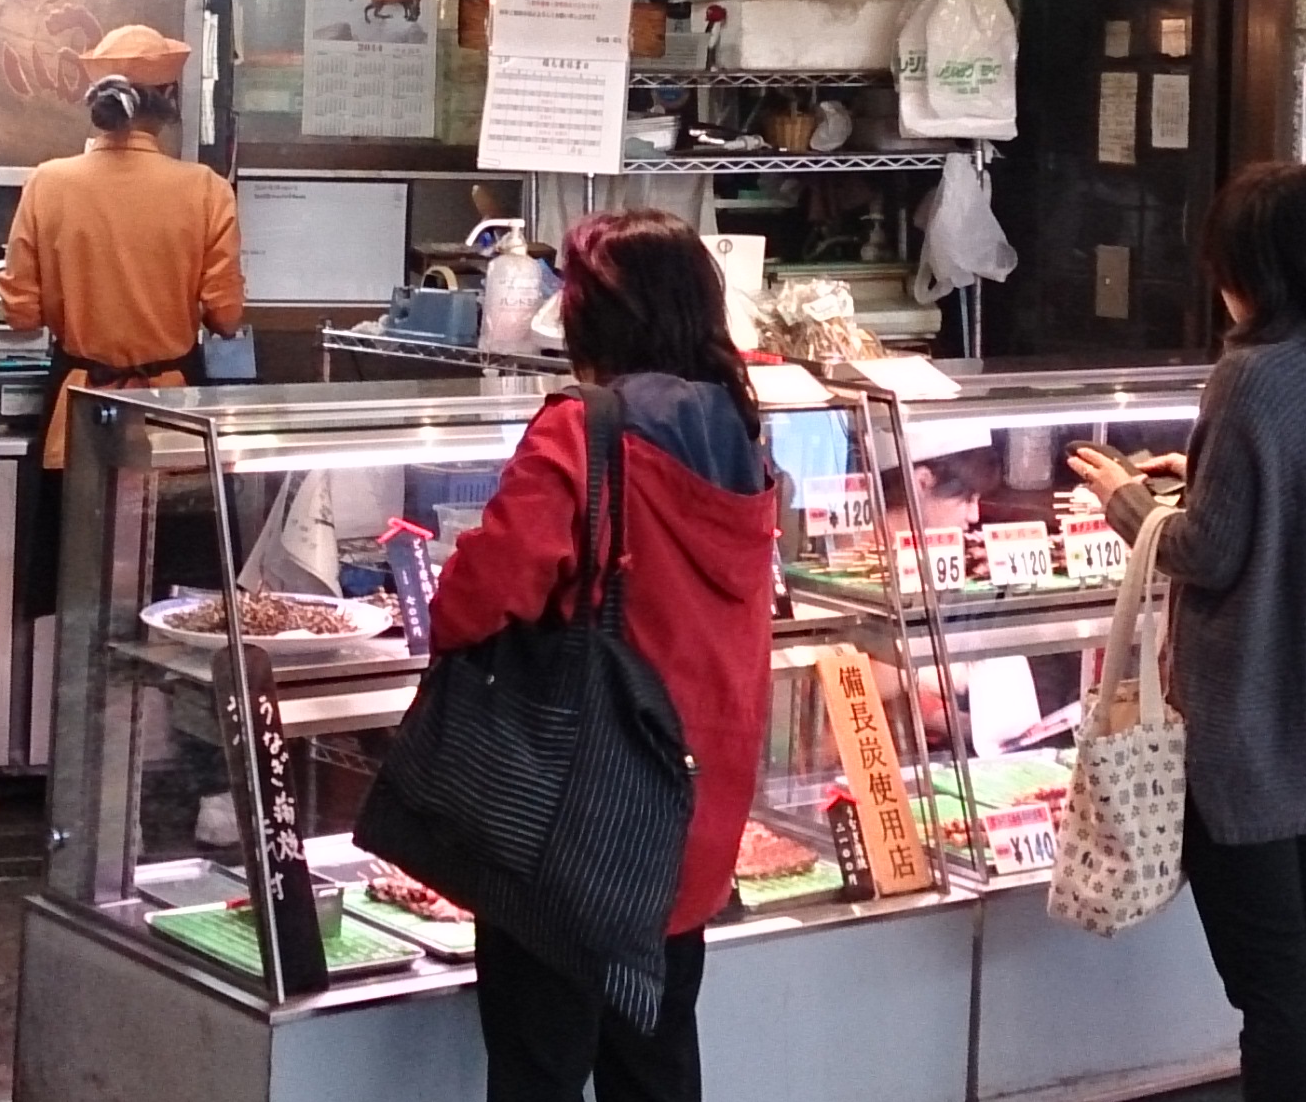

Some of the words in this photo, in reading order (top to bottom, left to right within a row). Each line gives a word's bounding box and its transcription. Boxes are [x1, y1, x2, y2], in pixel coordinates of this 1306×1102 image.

[1009, 550, 1047, 578] ¥120
[1084, 540, 1121, 569] ¥120
[839, 665, 916, 880] 備長炭使用店
[1010, 832, 1054, 866] ¥140
